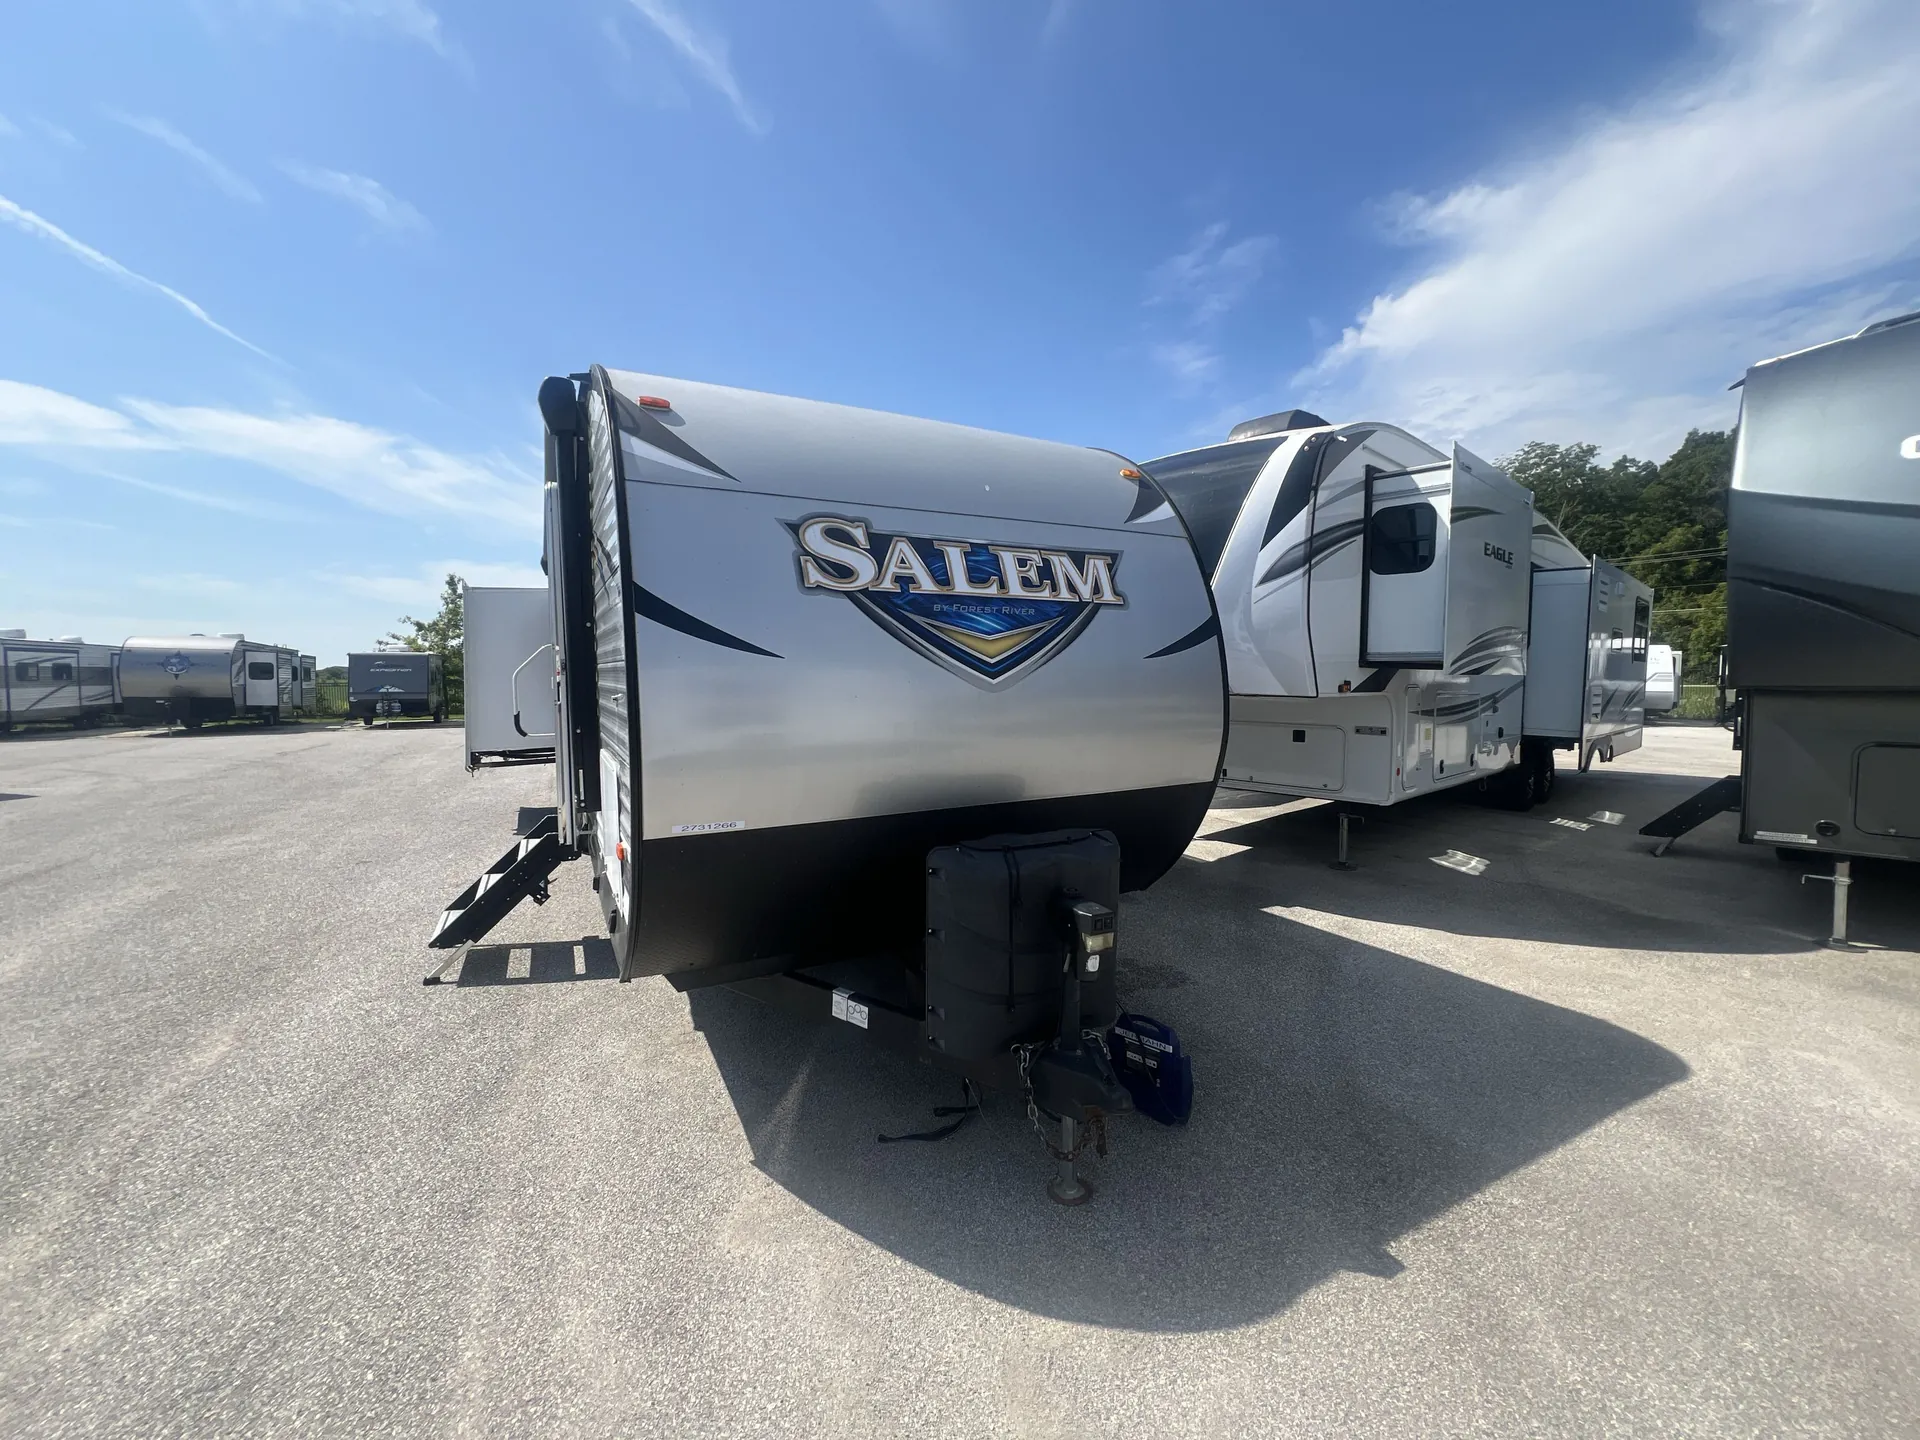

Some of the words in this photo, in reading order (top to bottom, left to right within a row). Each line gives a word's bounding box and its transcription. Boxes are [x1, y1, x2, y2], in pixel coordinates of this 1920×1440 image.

[799, 517, 1124, 605] SALEM
[1484, 541, 1514, 566] EAGLE
[952, 604, 999, 614] FOREST
[1001, 606, 1035, 616] RIVER
[681, 821, 738, 832] 2731266
